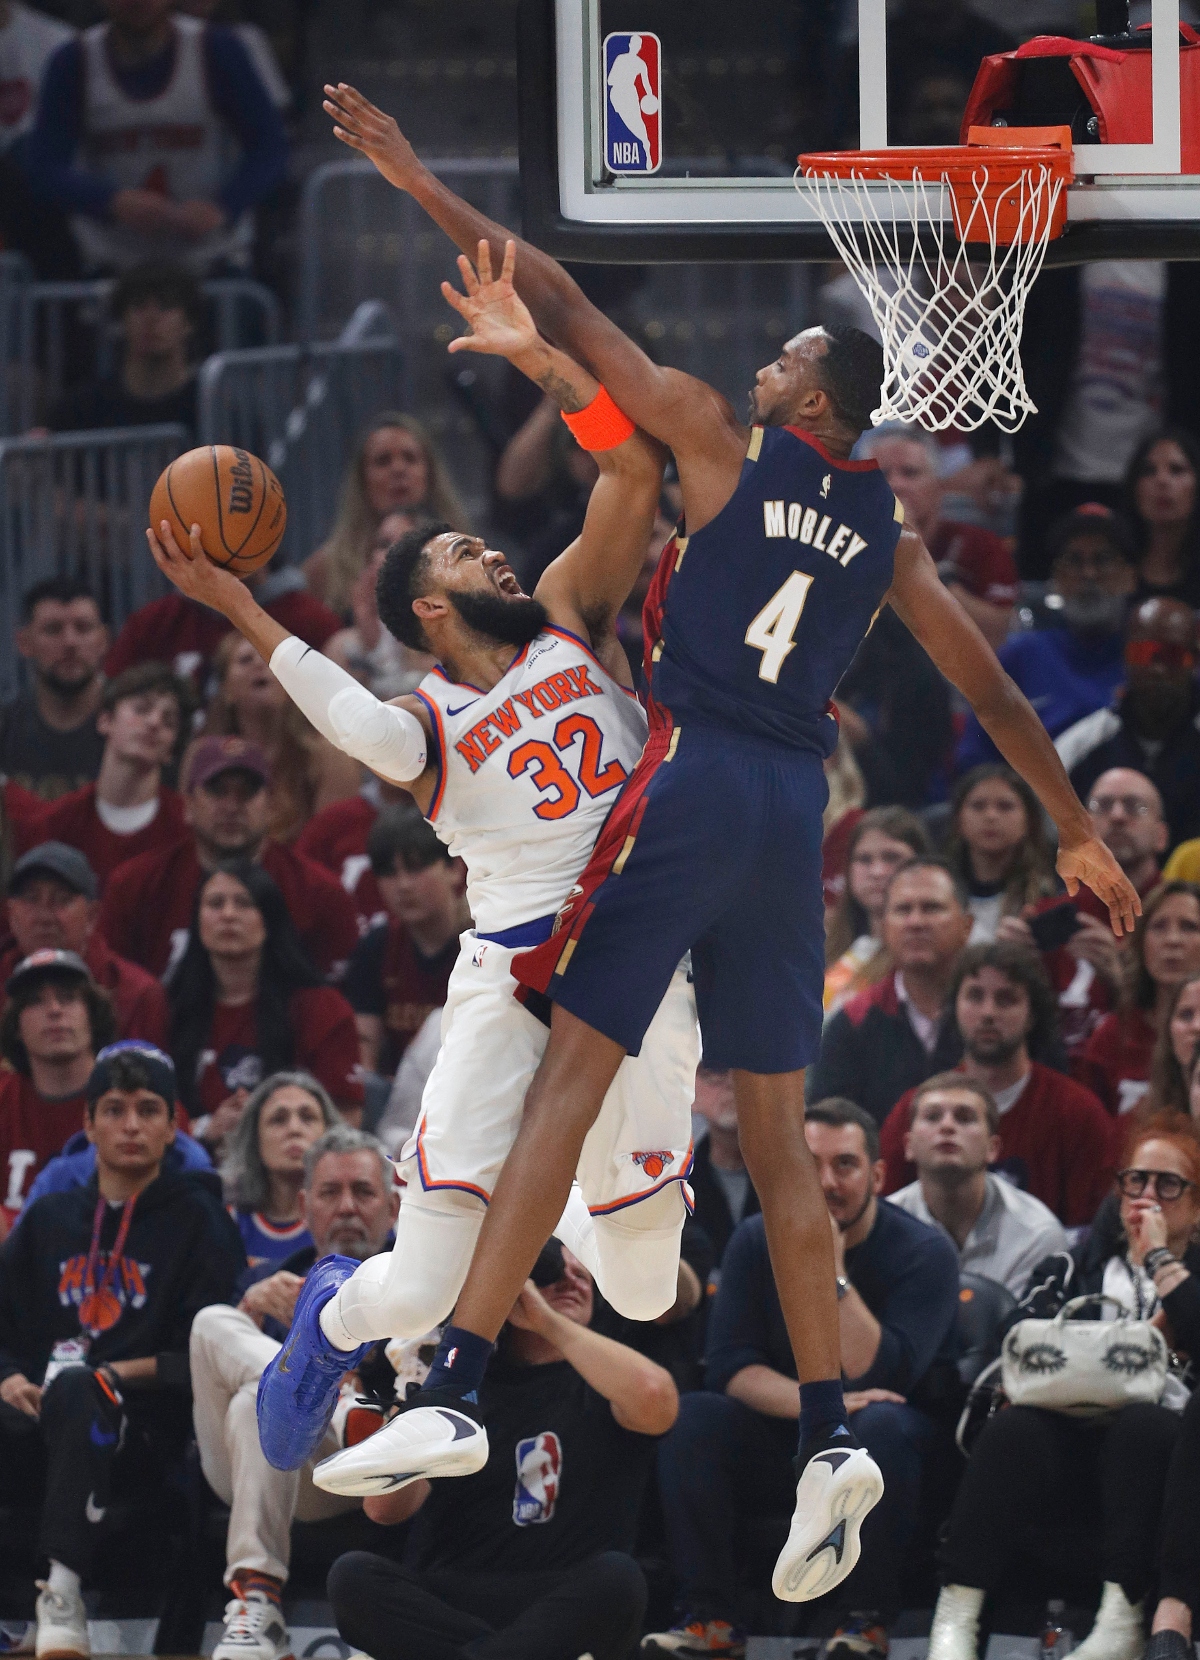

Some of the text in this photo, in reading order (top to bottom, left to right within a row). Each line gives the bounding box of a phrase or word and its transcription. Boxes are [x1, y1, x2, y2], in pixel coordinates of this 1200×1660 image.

[613, 142, 640, 165] NBA
[763, 500, 868, 568] MOBLEY
[744, 569, 815, 684] 4
[454, 664, 604, 775] NEW YORK
[506, 712, 628, 821] 32
